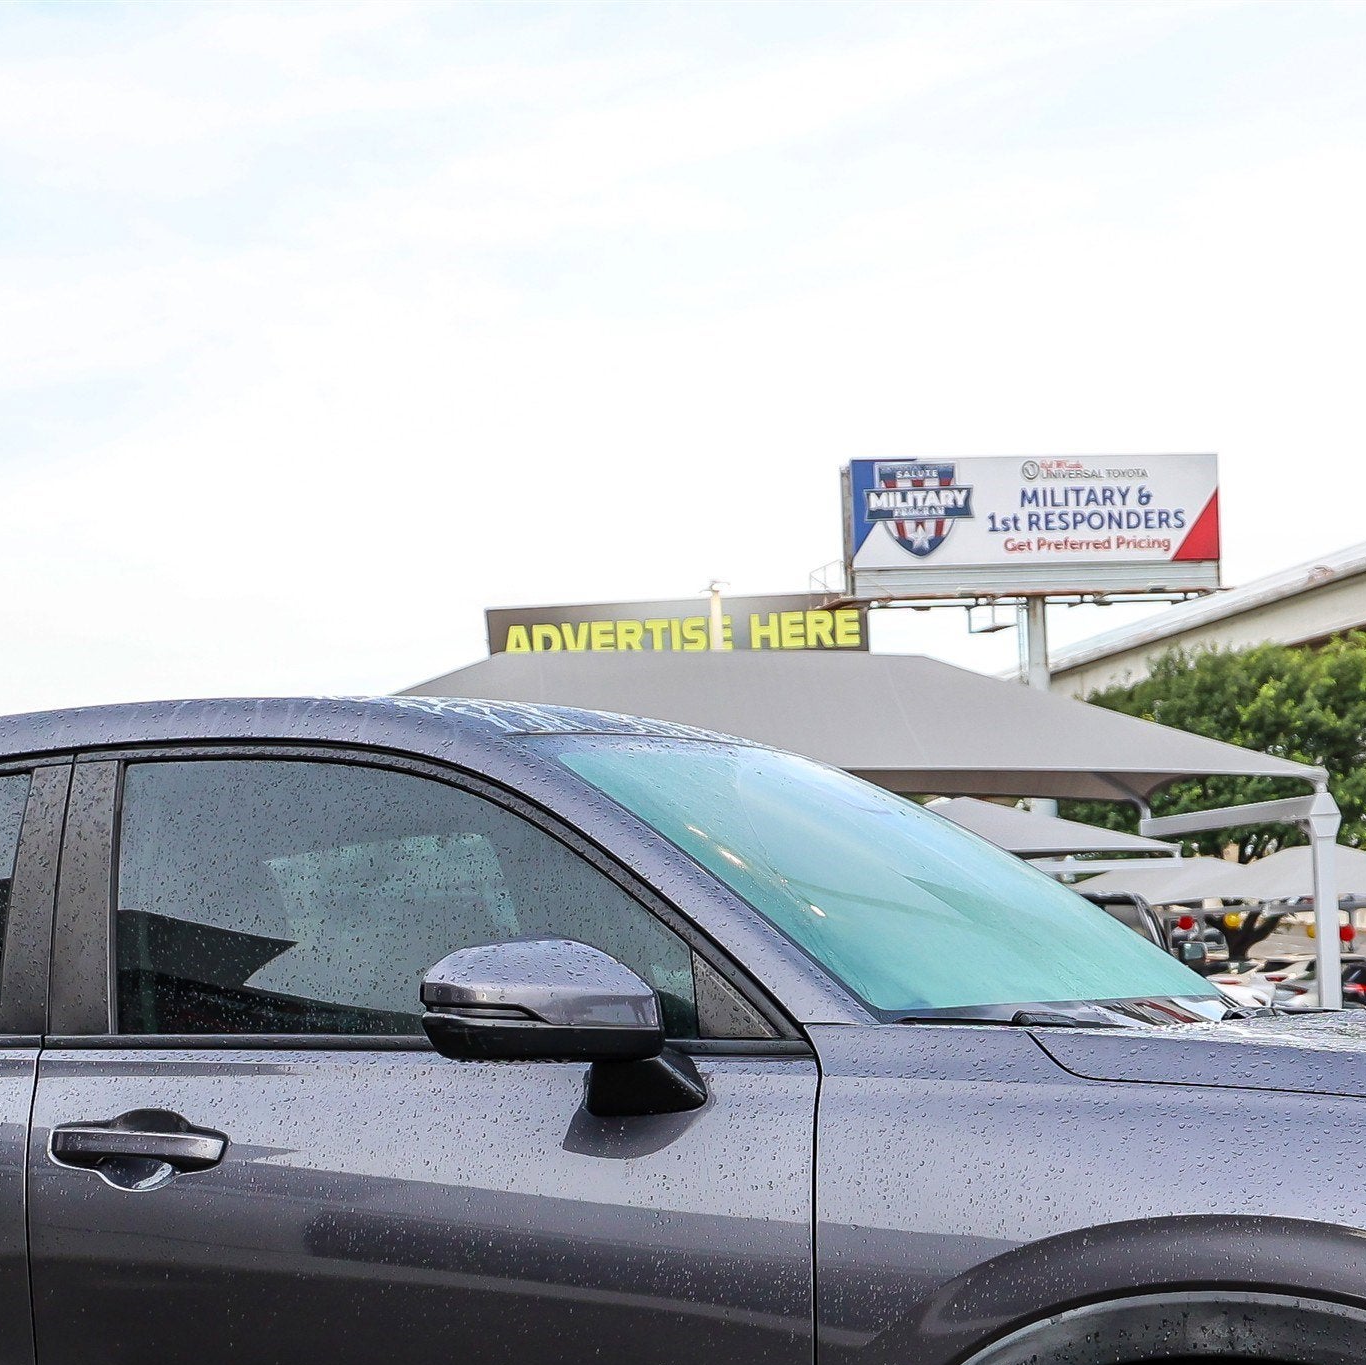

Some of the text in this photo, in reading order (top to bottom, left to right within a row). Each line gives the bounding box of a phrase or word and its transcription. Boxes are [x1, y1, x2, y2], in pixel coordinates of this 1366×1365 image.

[896, 469, 938, 478] SALUTE
[1040, 468, 1148, 479] UNIVERSAL TOYOTA
[868, 489, 967, 511] MILITARY
[1020, 485, 1153, 508] MILITARY &
[987, 508, 1185, 532] 1st RESPONDERS
[1003, 535, 1171, 552] Get Preferred Pricing
[505, 609, 861, 652] ADVERTISE HERE
